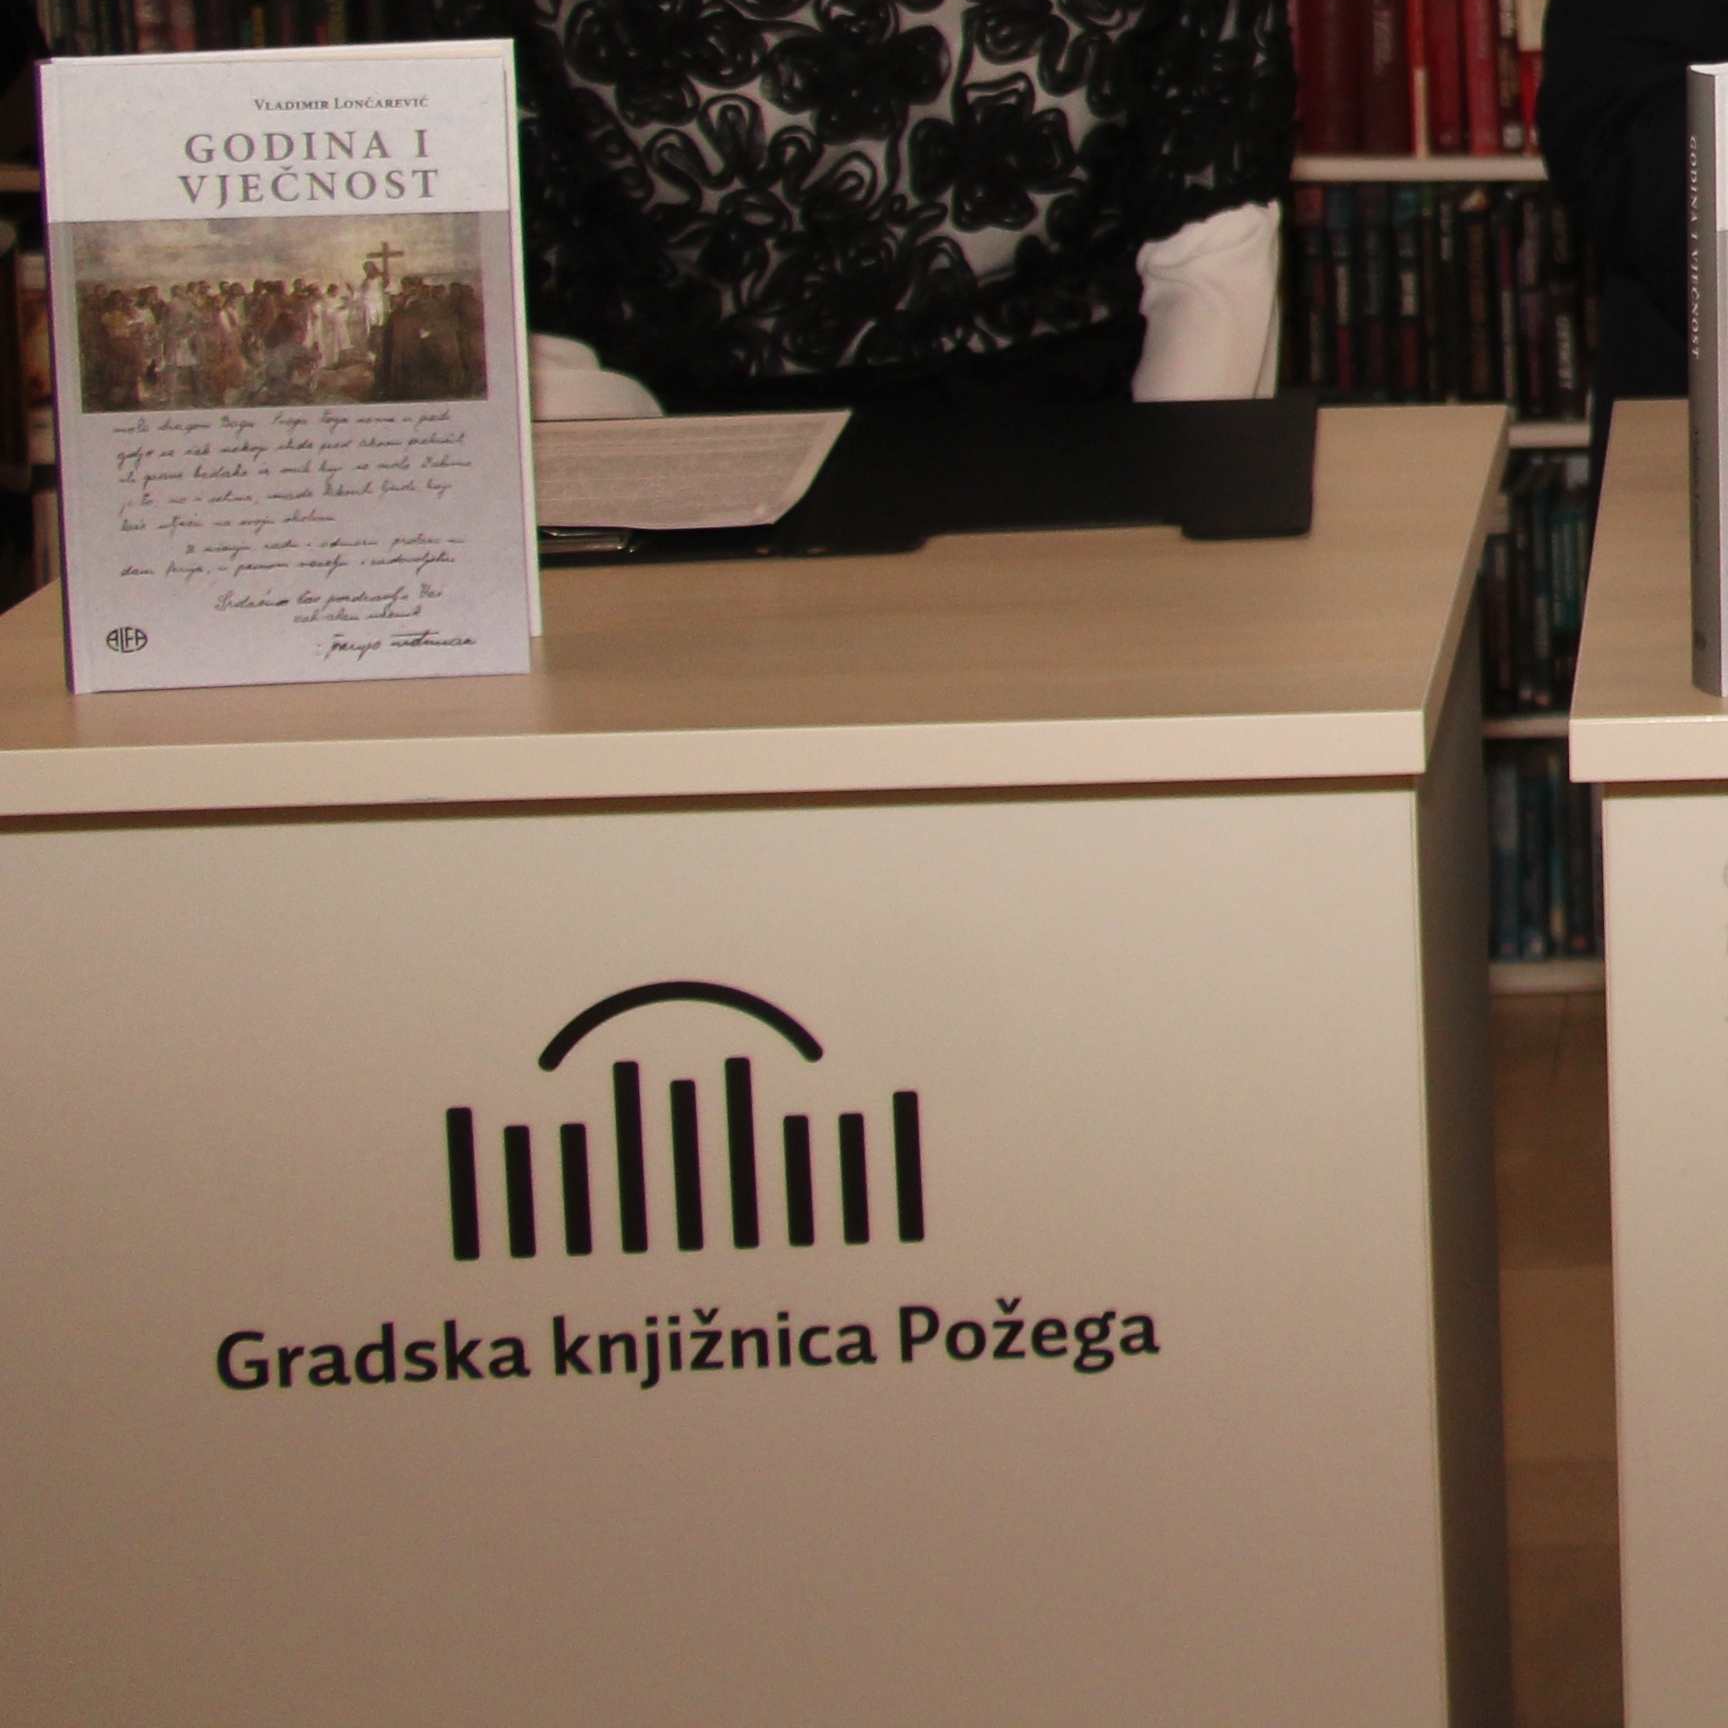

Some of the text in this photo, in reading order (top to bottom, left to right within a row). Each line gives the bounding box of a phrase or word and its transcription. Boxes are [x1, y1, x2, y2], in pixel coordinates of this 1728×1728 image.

[184, 128, 429, 164] GODINA I
[178, 165, 439, 209] VJEČNOST
[105, 626, 149, 654] ALFA
[215, 1298, 1161, 1392] Gradska knjižnica Požega
